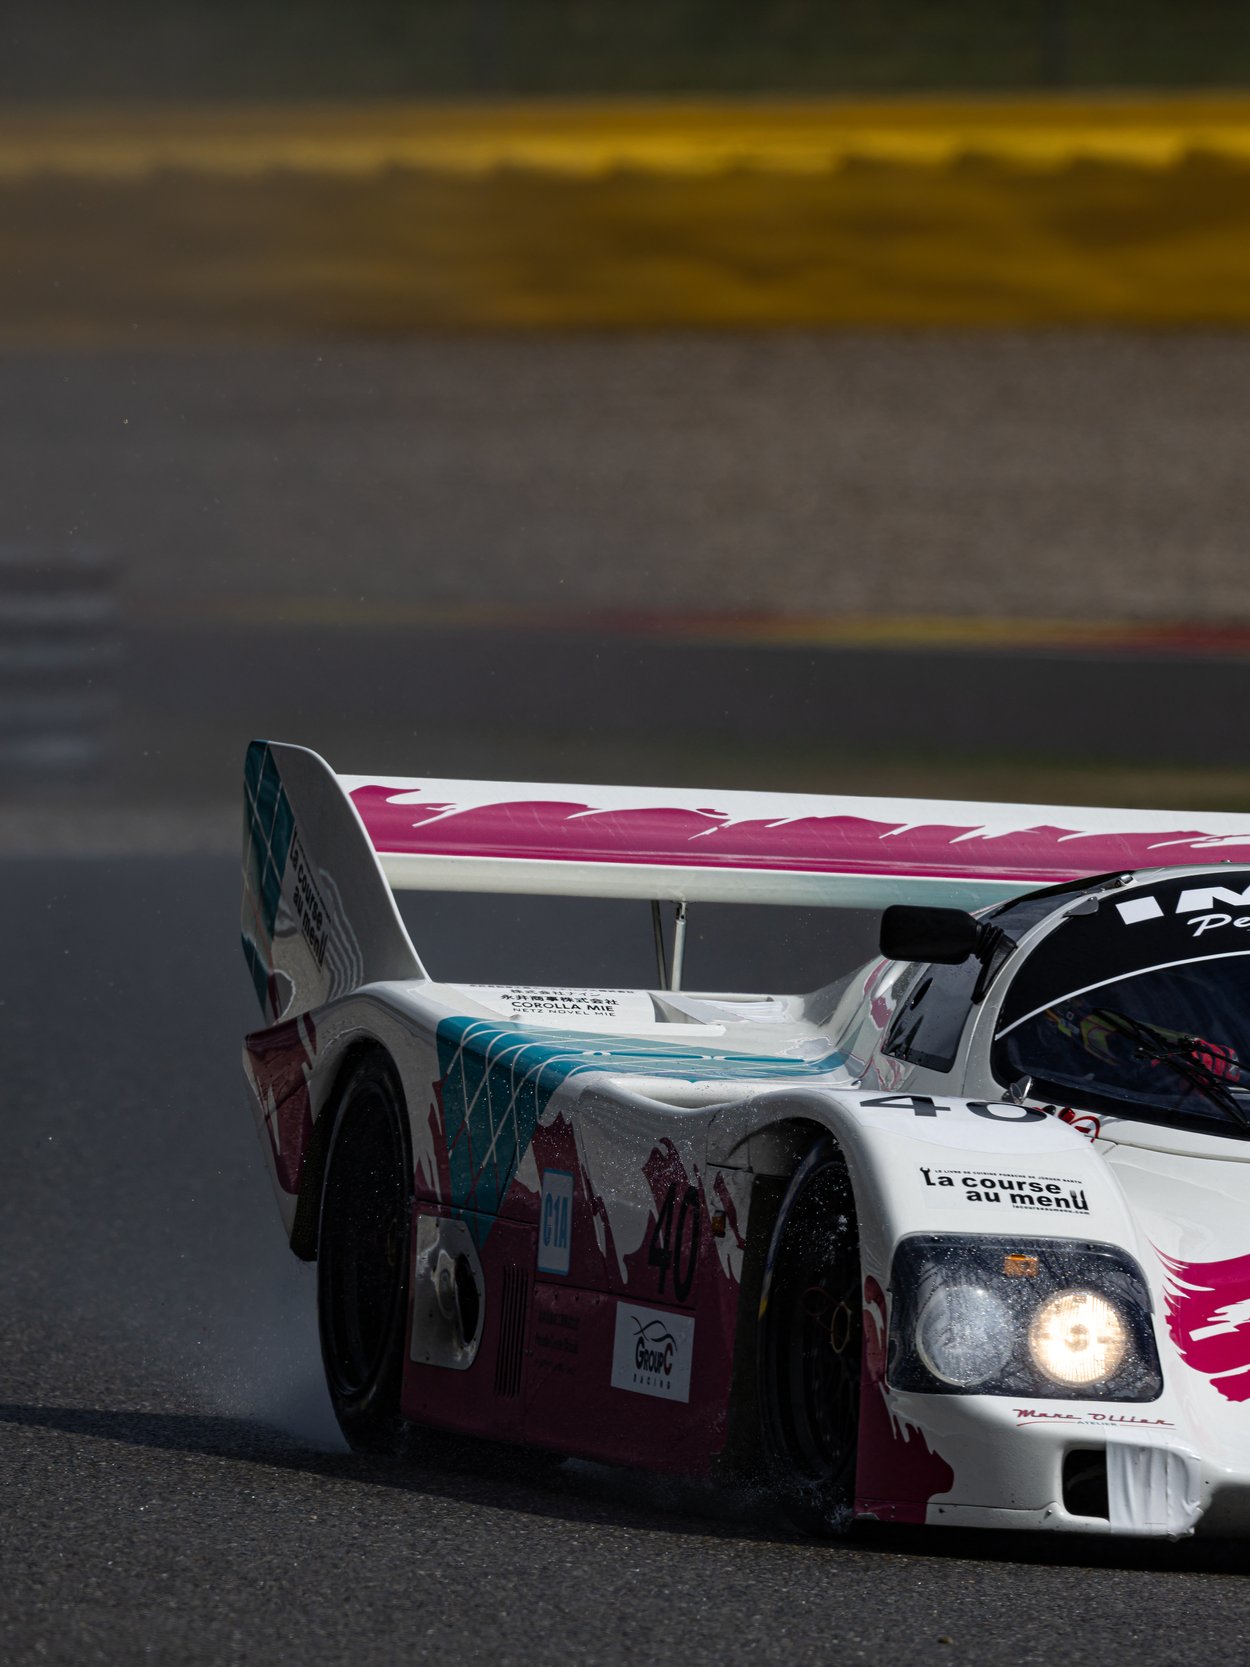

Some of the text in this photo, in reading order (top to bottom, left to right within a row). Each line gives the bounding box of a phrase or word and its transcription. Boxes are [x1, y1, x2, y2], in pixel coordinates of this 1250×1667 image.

[293, 886, 304, 917] au
[297, 863, 323, 932] course
[512, 1001, 614, 1012] COROLLA MIE
[859, 1095, 1047, 1123] 40
[920, 1167, 1061, 1195] La course
[966, 1188, 1089, 1210] au menu
[543, 1192, 568, 1249] C1A
[649, 1182, 700, 1302] 40
[1013, 1408, 1082, 1419] Marc
